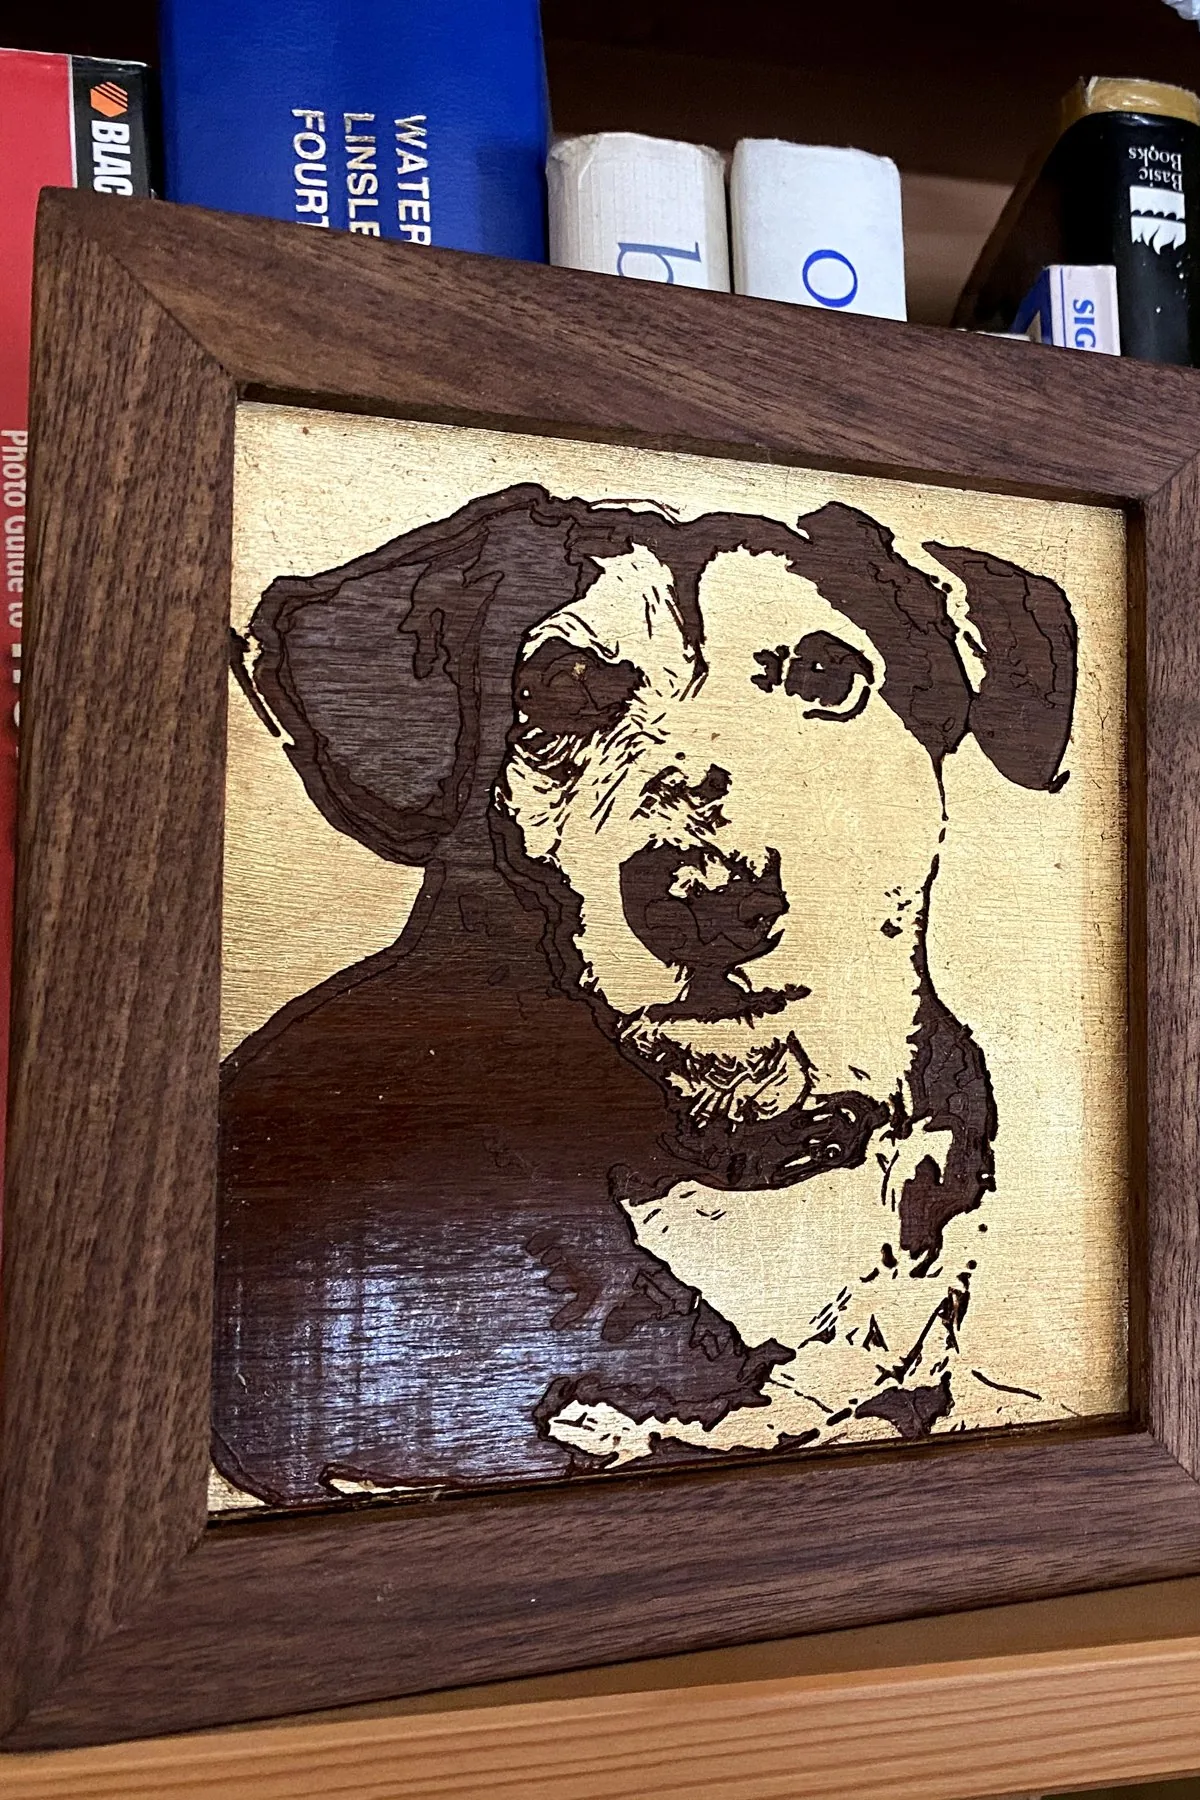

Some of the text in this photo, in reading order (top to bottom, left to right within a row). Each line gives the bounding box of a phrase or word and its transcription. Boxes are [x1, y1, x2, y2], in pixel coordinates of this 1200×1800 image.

[91, 119, 133, 197] BLAC
[394, 114, 432, 246] WATER
[1128, 145, 1183, 172] Books
[1138, 166, 1184, 192] Basic
[1073, 299, 1097, 349] SIG
